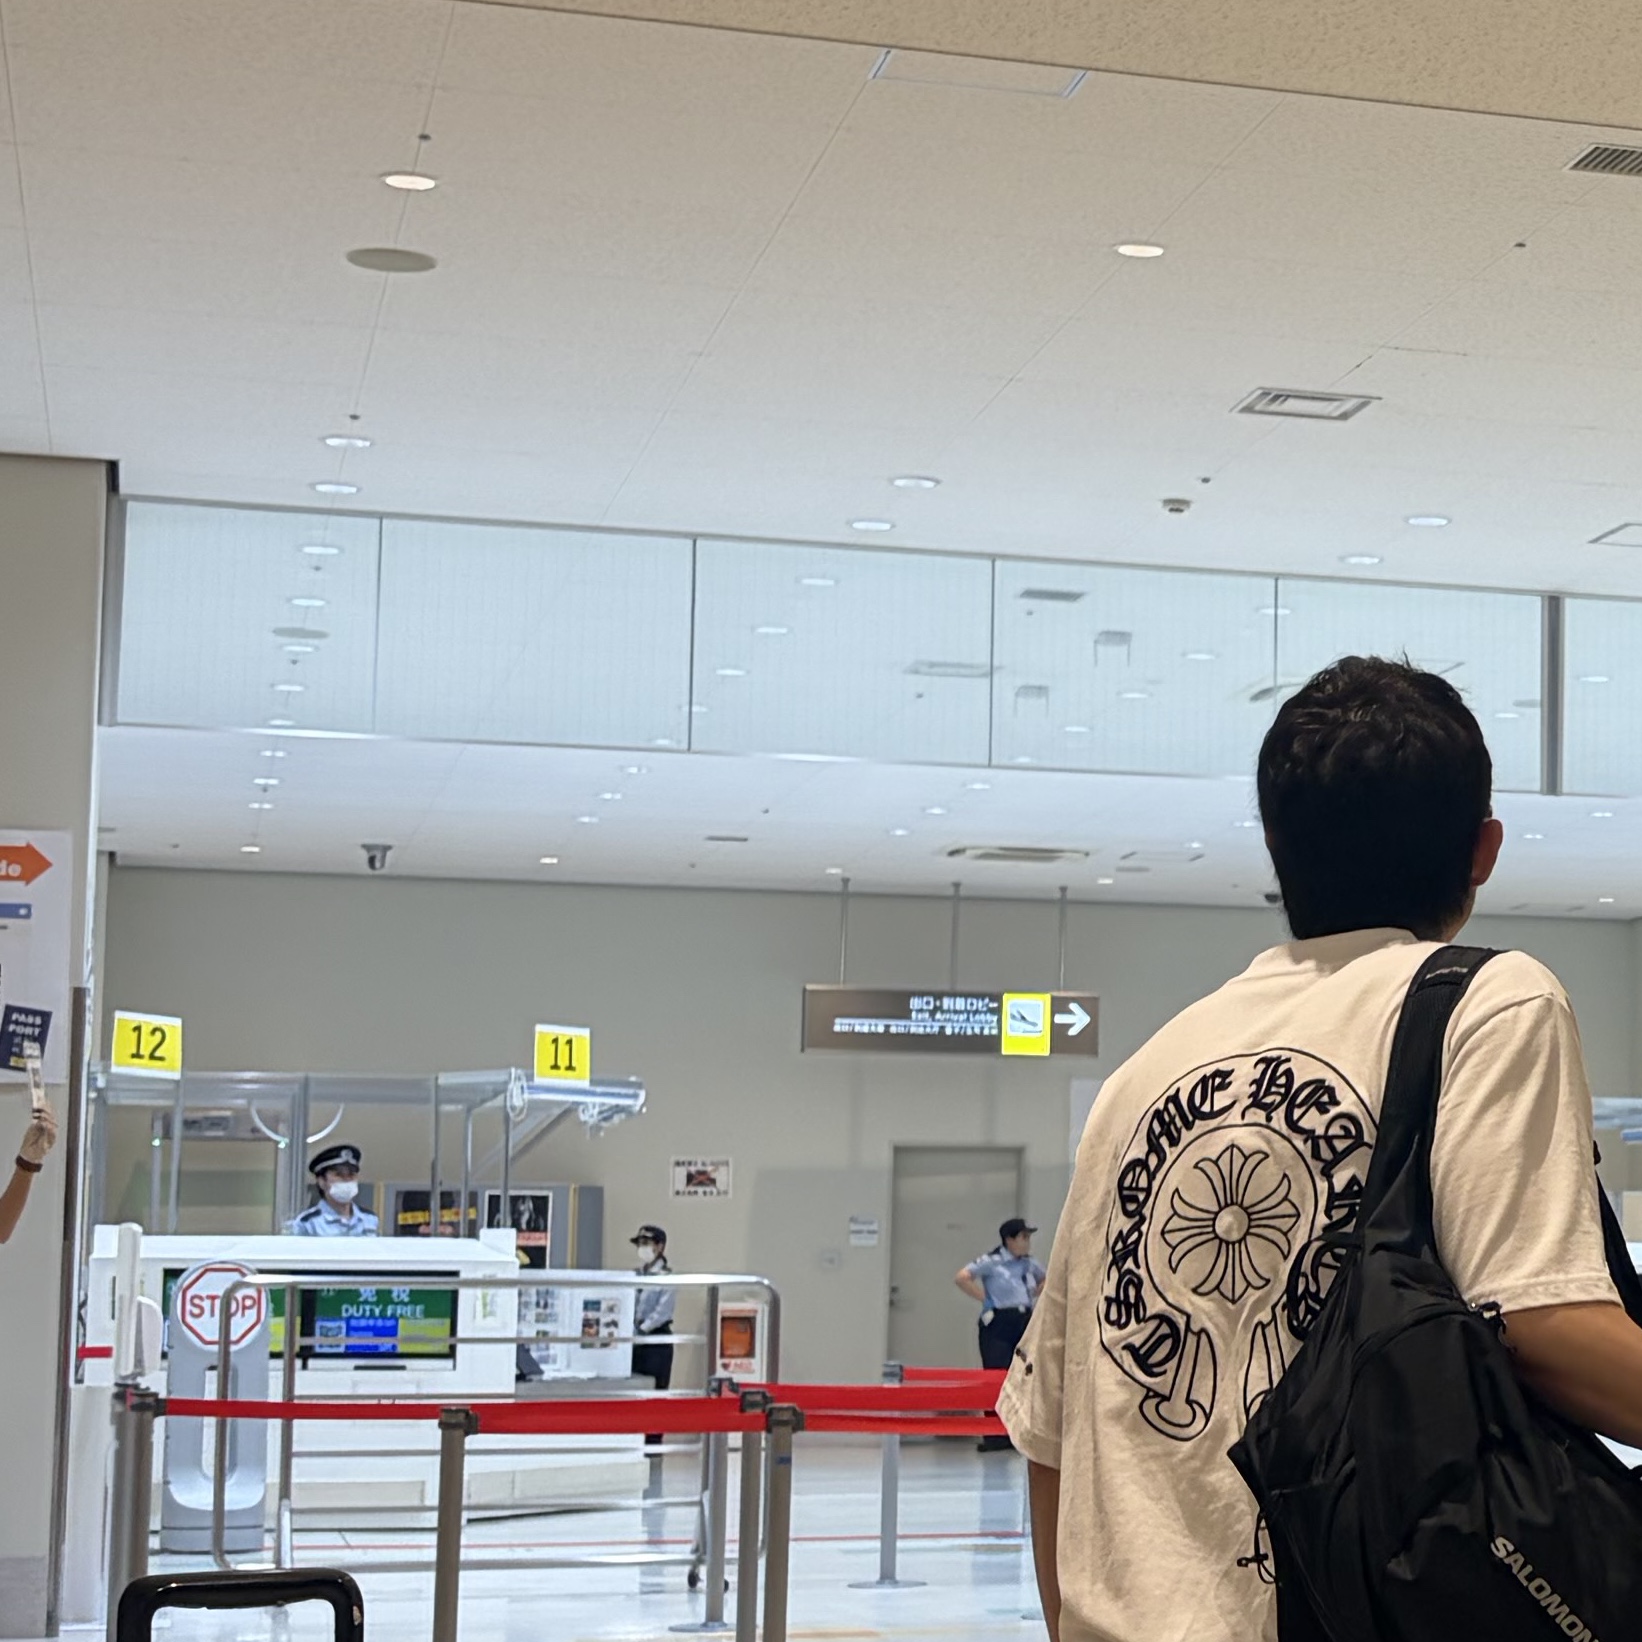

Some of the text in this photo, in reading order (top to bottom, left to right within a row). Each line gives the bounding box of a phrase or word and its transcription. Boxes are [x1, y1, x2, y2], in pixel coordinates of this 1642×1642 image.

[12, 1012, 42, 1025] PASS
[9, 1023, 42, 1037] PORT
[131, 1023, 166, 1061] 12
[550, 1036, 576, 1072] 11
[189, 1294, 257, 1318] STOP
[342, 1304, 425, 1318] DUTY FREE
